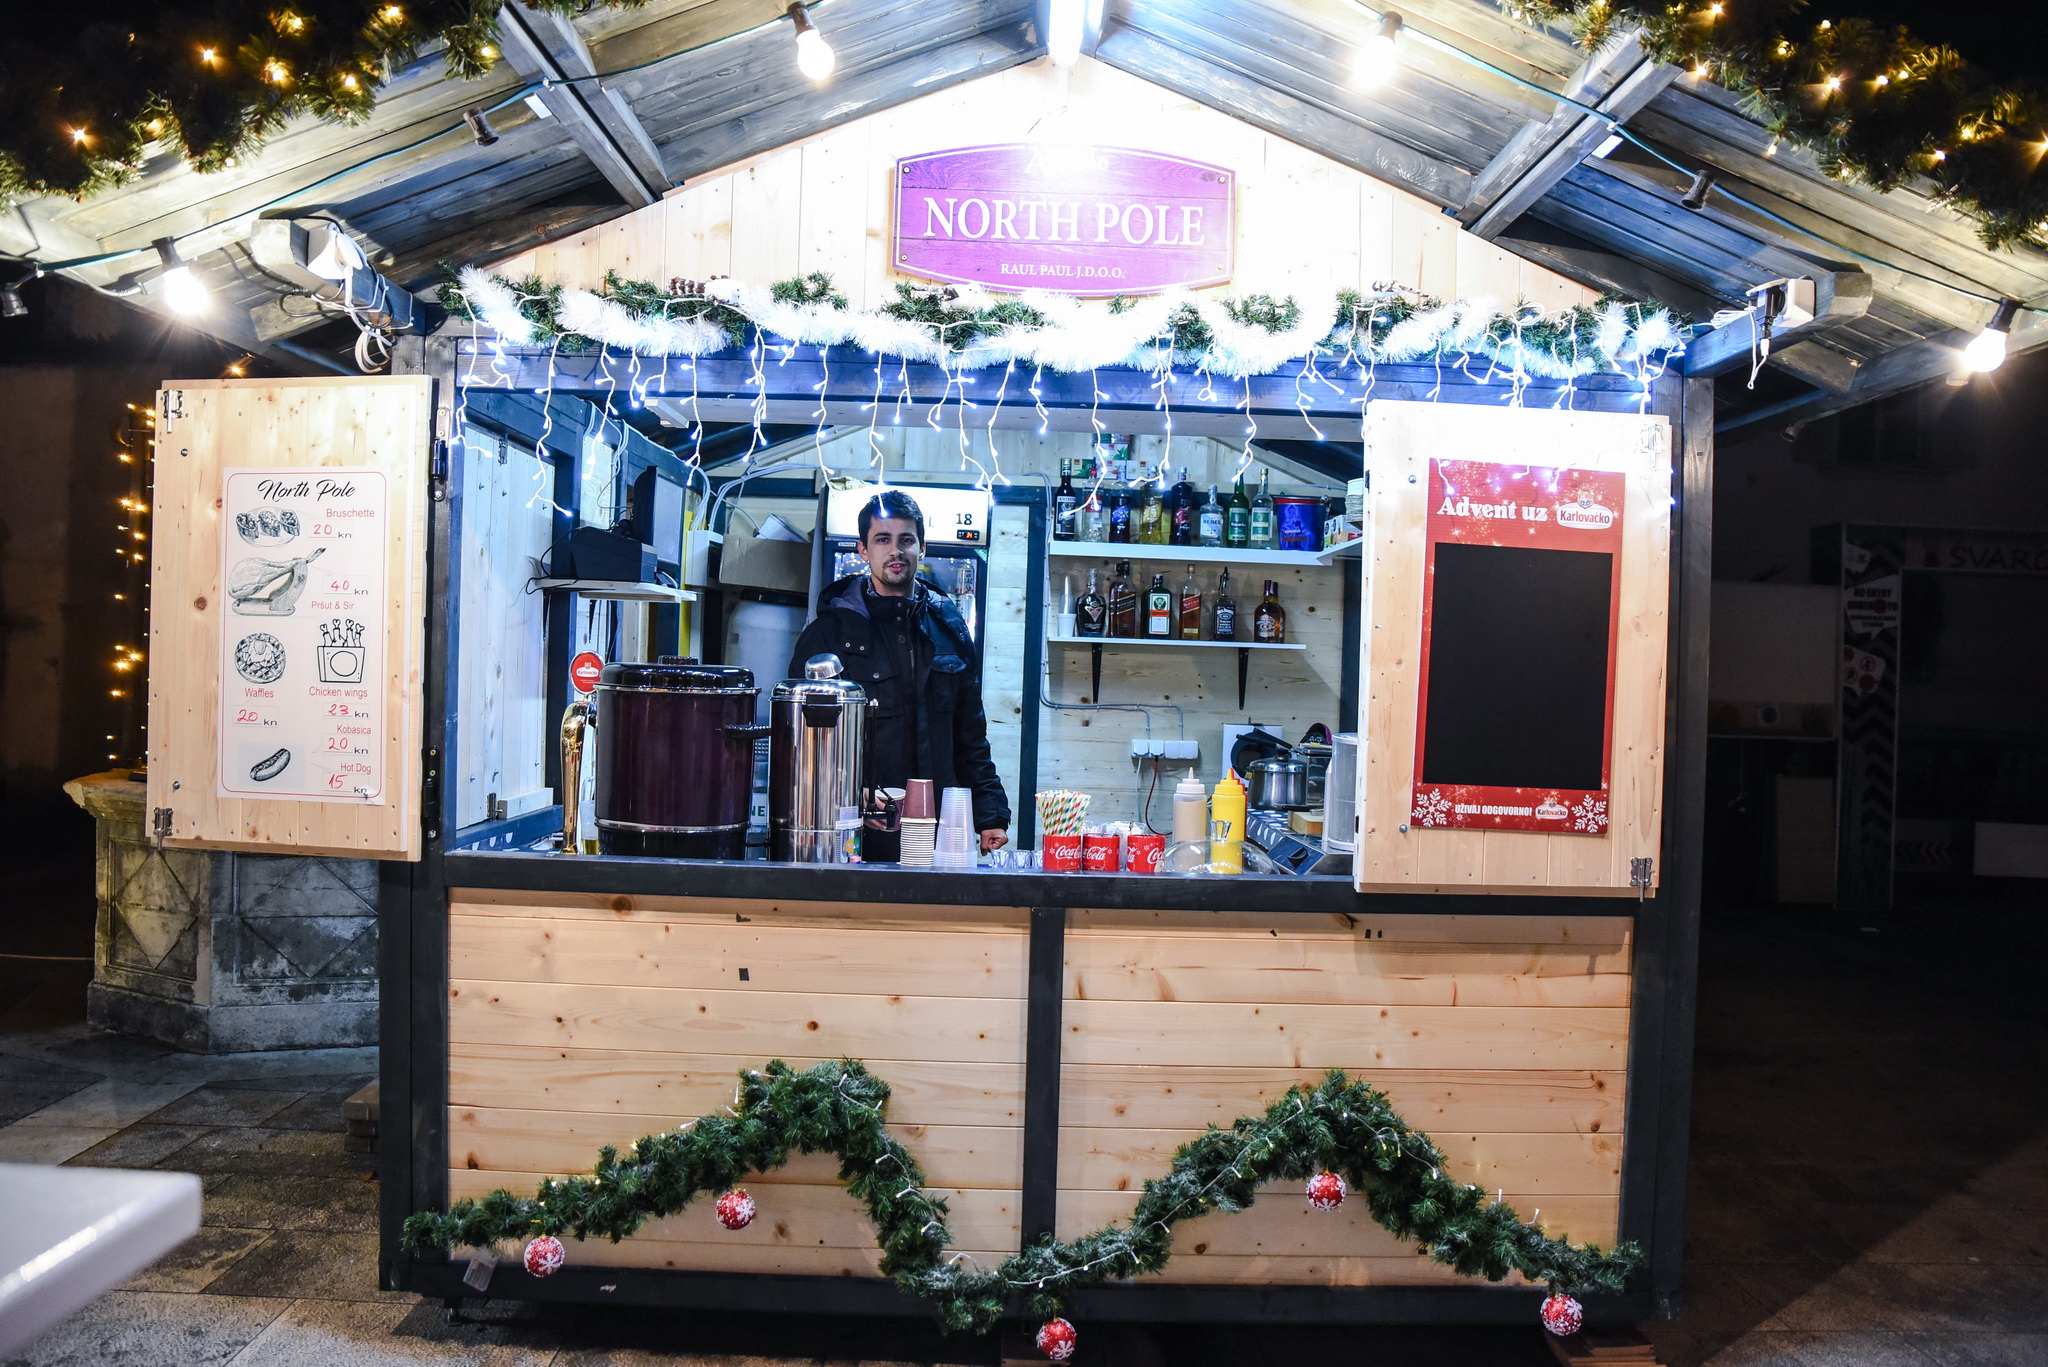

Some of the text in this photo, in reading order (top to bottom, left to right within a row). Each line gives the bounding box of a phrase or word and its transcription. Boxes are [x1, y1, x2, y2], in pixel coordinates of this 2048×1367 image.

[923, 197, 1205, 246] NORTH POLE
[1001, 263, 1125, 279] RAUL PAUL J.D.O.O.
[257, 479, 356, 502] North Pole
[326, 508, 375, 518] Bruschette
[1437, 495, 1517, 519] Advent
[1521, 507, 1548, 522] uz
[955, 512, 973, 526] 18
[313, 524, 333, 535] 20
[330, 580, 350, 591] 40
[311, 600, 355, 610] Pršut & Sir
[244, 687, 274, 698] Waffles
[309, 686, 368, 699] Chicken wings
[328, 703, 349, 715] 23
[236, 709, 259, 722] 20
[336, 725, 372, 735] Kobasica
[328, 737, 348, 750] 20
[340, 763, 372, 775] Hot Dog
[328, 774, 349, 789] 15
[1455, 803, 1481, 814] UŽIVAJ
[1482, 805, 1532, 815] ODGOVORNO!
